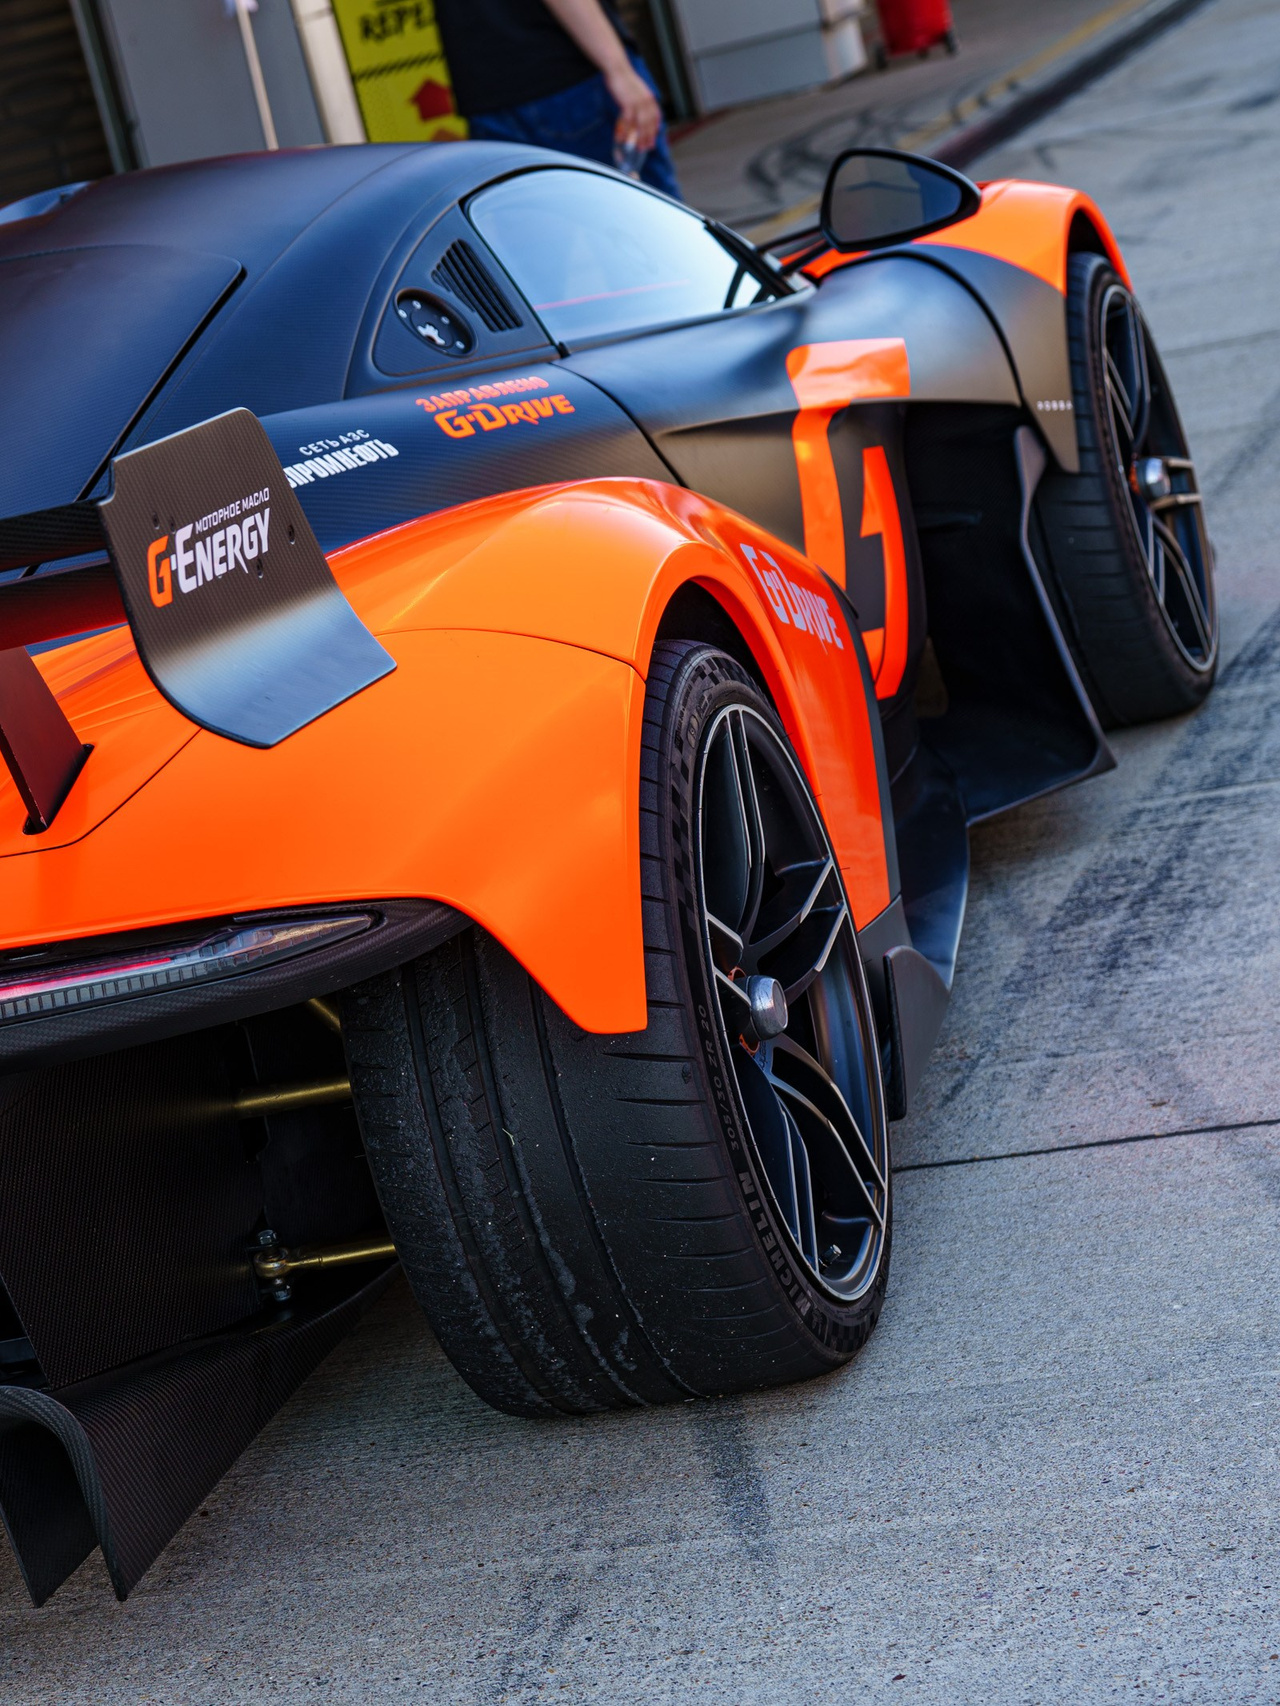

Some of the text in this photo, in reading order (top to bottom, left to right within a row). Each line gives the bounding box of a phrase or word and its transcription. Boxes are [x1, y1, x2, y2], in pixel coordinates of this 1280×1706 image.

[415, 376, 550, 413] ЗАПРАВЛЕНО
[298, 429, 370, 456] СЕТЬ АЗС
[194, 487, 270, 535] МОТОРНОЕ МАСЛО
[698, 1004, 740, 1152] 305/30 ZR 20
[738, 1171, 812, 1318] MICHELIN
